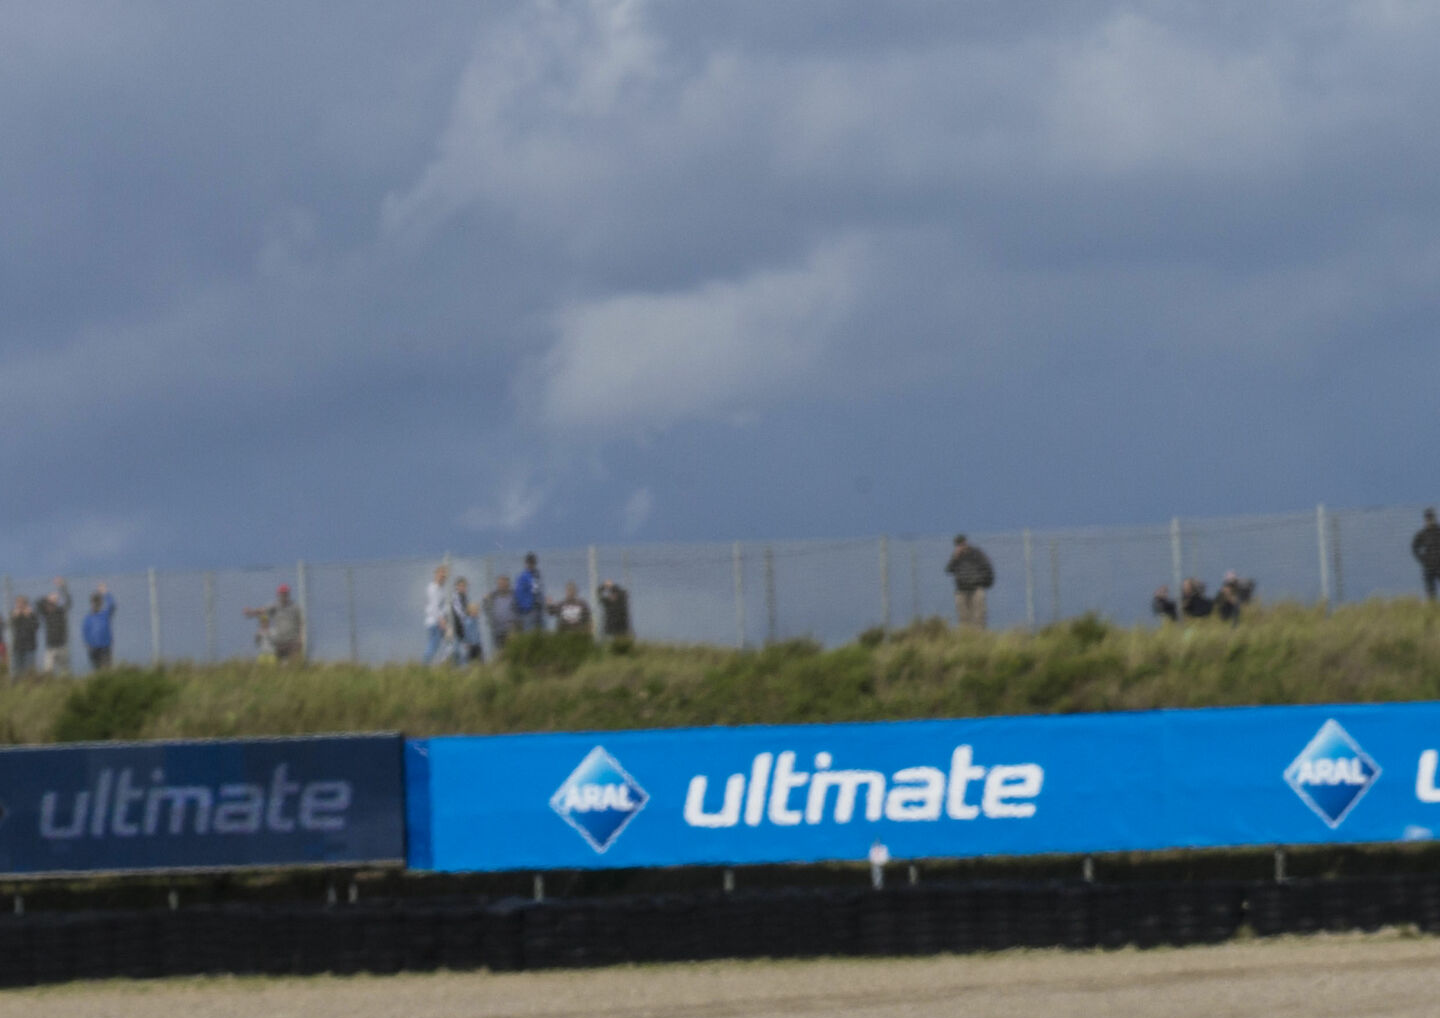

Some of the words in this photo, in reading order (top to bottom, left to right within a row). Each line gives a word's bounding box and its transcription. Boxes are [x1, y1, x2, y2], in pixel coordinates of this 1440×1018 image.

[563, 782, 634, 812] ARAL
[683, 744, 1045, 828] ultimate
[1298, 757, 1368, 785] ARAL
[40, 763, 352, 840] ultimate
